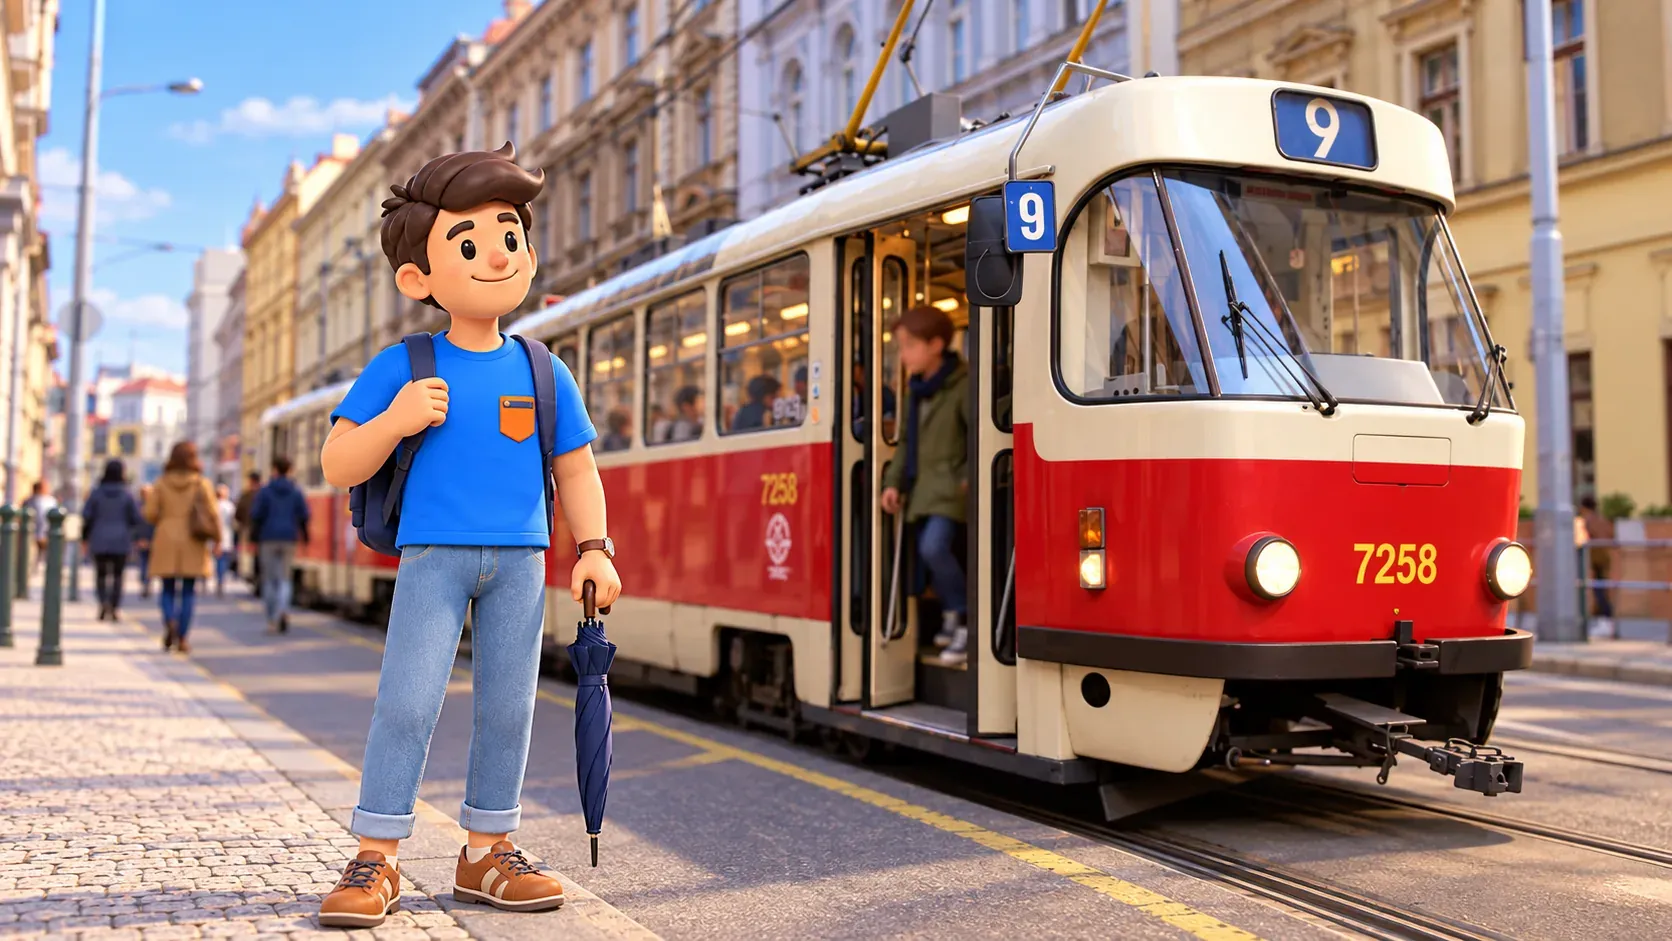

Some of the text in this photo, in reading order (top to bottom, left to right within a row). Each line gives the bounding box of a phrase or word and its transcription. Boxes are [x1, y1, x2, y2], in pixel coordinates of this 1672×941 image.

[1305, 98, 1340, 159] 9
[1019, 192, 1045, 241] 9
[760, 473, 798, 506] 7258
[1353, 543, 1437, 584] 7258
